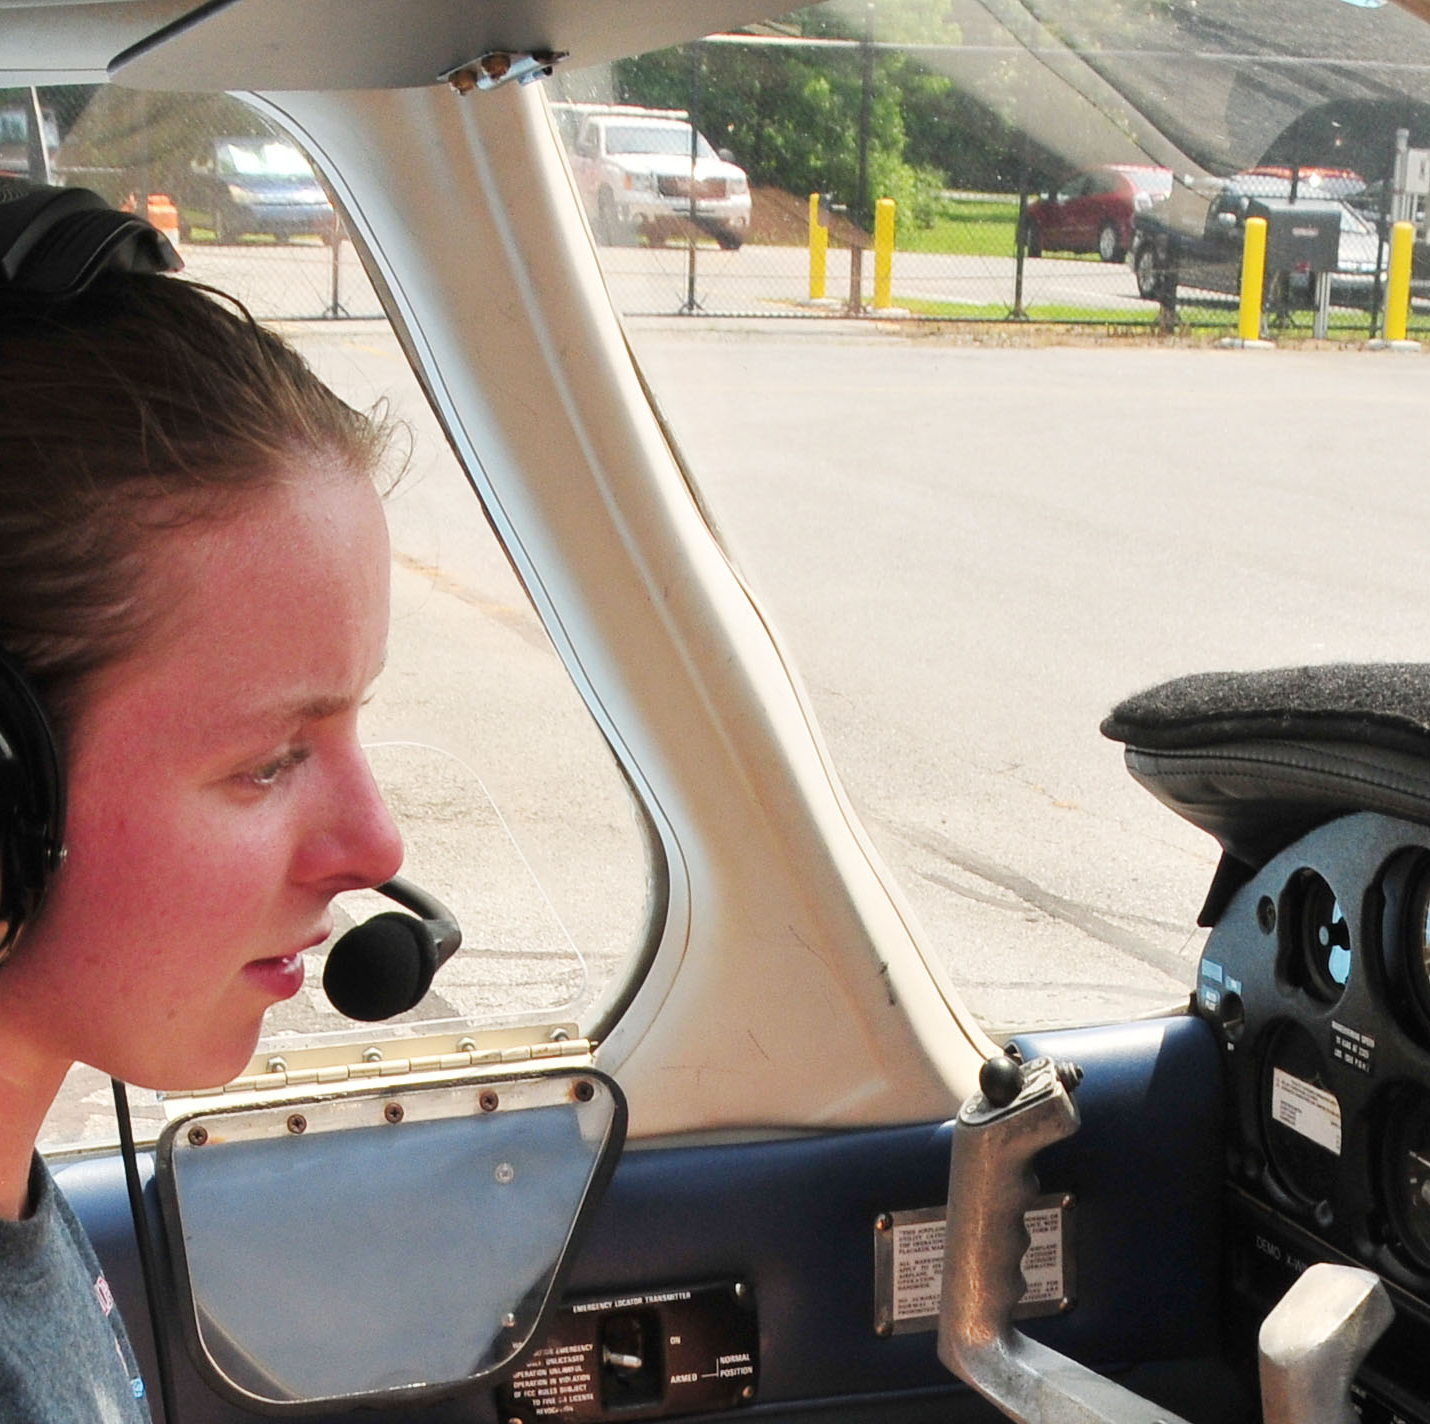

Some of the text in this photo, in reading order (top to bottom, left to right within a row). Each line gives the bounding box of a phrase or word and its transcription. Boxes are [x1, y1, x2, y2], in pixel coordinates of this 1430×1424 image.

[670, 1336, 681, 1345] ON
[720, 1354, 751, 1364] NORMAL
[720, 1366, 753, 1377] POSITION
[670, 1373, 698, 1385] ARMED
